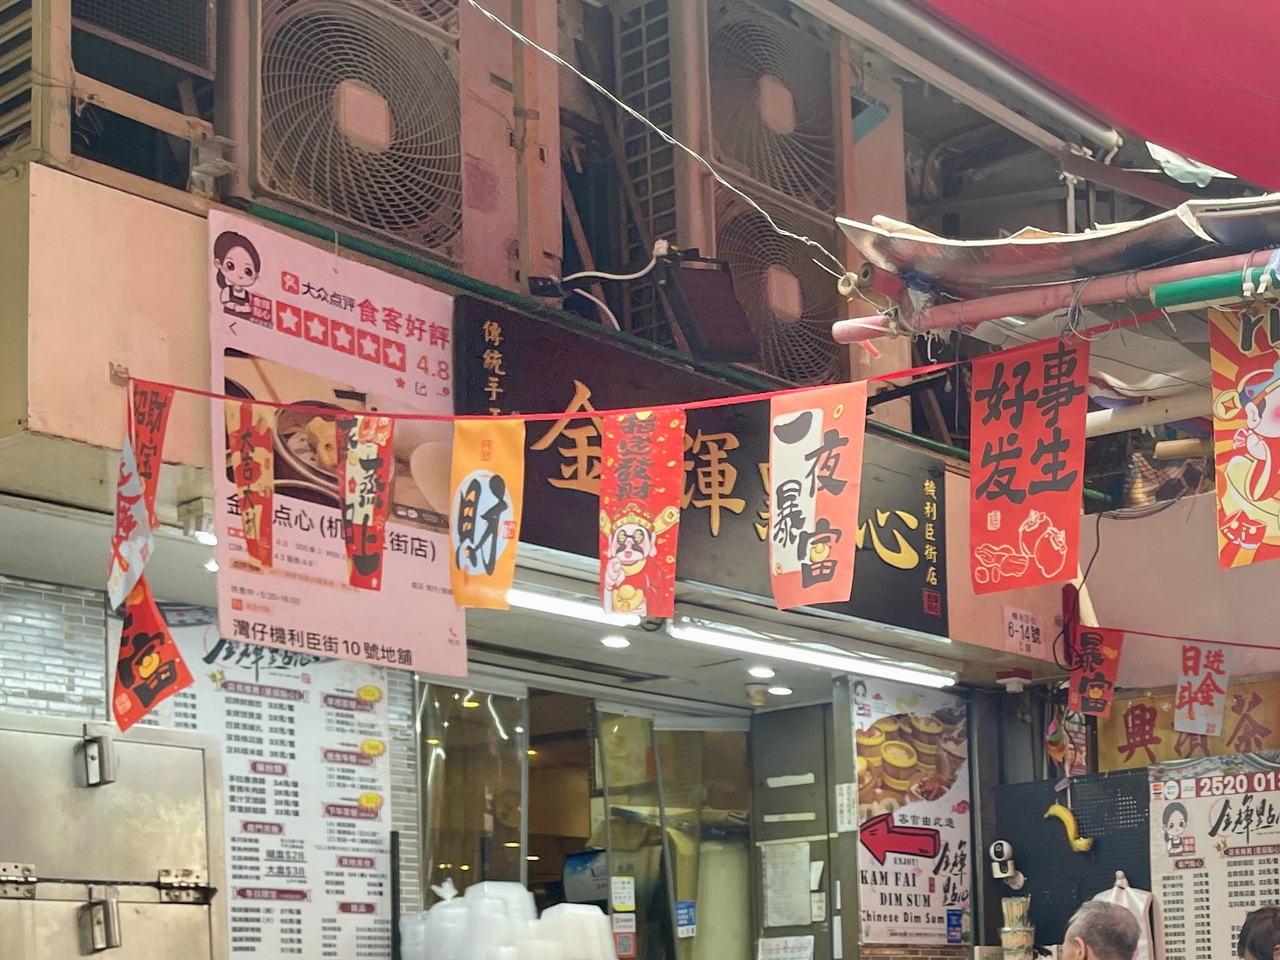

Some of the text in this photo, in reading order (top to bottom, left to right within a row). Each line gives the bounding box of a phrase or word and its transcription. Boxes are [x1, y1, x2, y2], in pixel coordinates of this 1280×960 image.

[302, 282, 356, 312] 大众点评
[358, 298, 449, 350] 食客好評
[417, 356, 449, 381] 4.8
[482, 320, 506, 416] 傳統手
[974, 342, 1085, 430] 好事
[530, 379, 920, 570] 金輝心
[975, 430, 1078, 506] 发生
[226, 493, 315, 533] 金点心
[923, 479, 938, 586] 機利臣街店
[1075, 631, 1113, 713] 暴富
[1182, 645, 1227, 676] 日进
[1176, 672, 1225, 720] 斗金
[1200, 775, 1248, 796] 2520
[861, 870, 888, 886] KAM
[894, 872, 916, 887] FAI
[880, 892, 931, 907] DIM SUM
[903, 912, 921, 923] Dim
[926, 912, 945, 923] Sum
